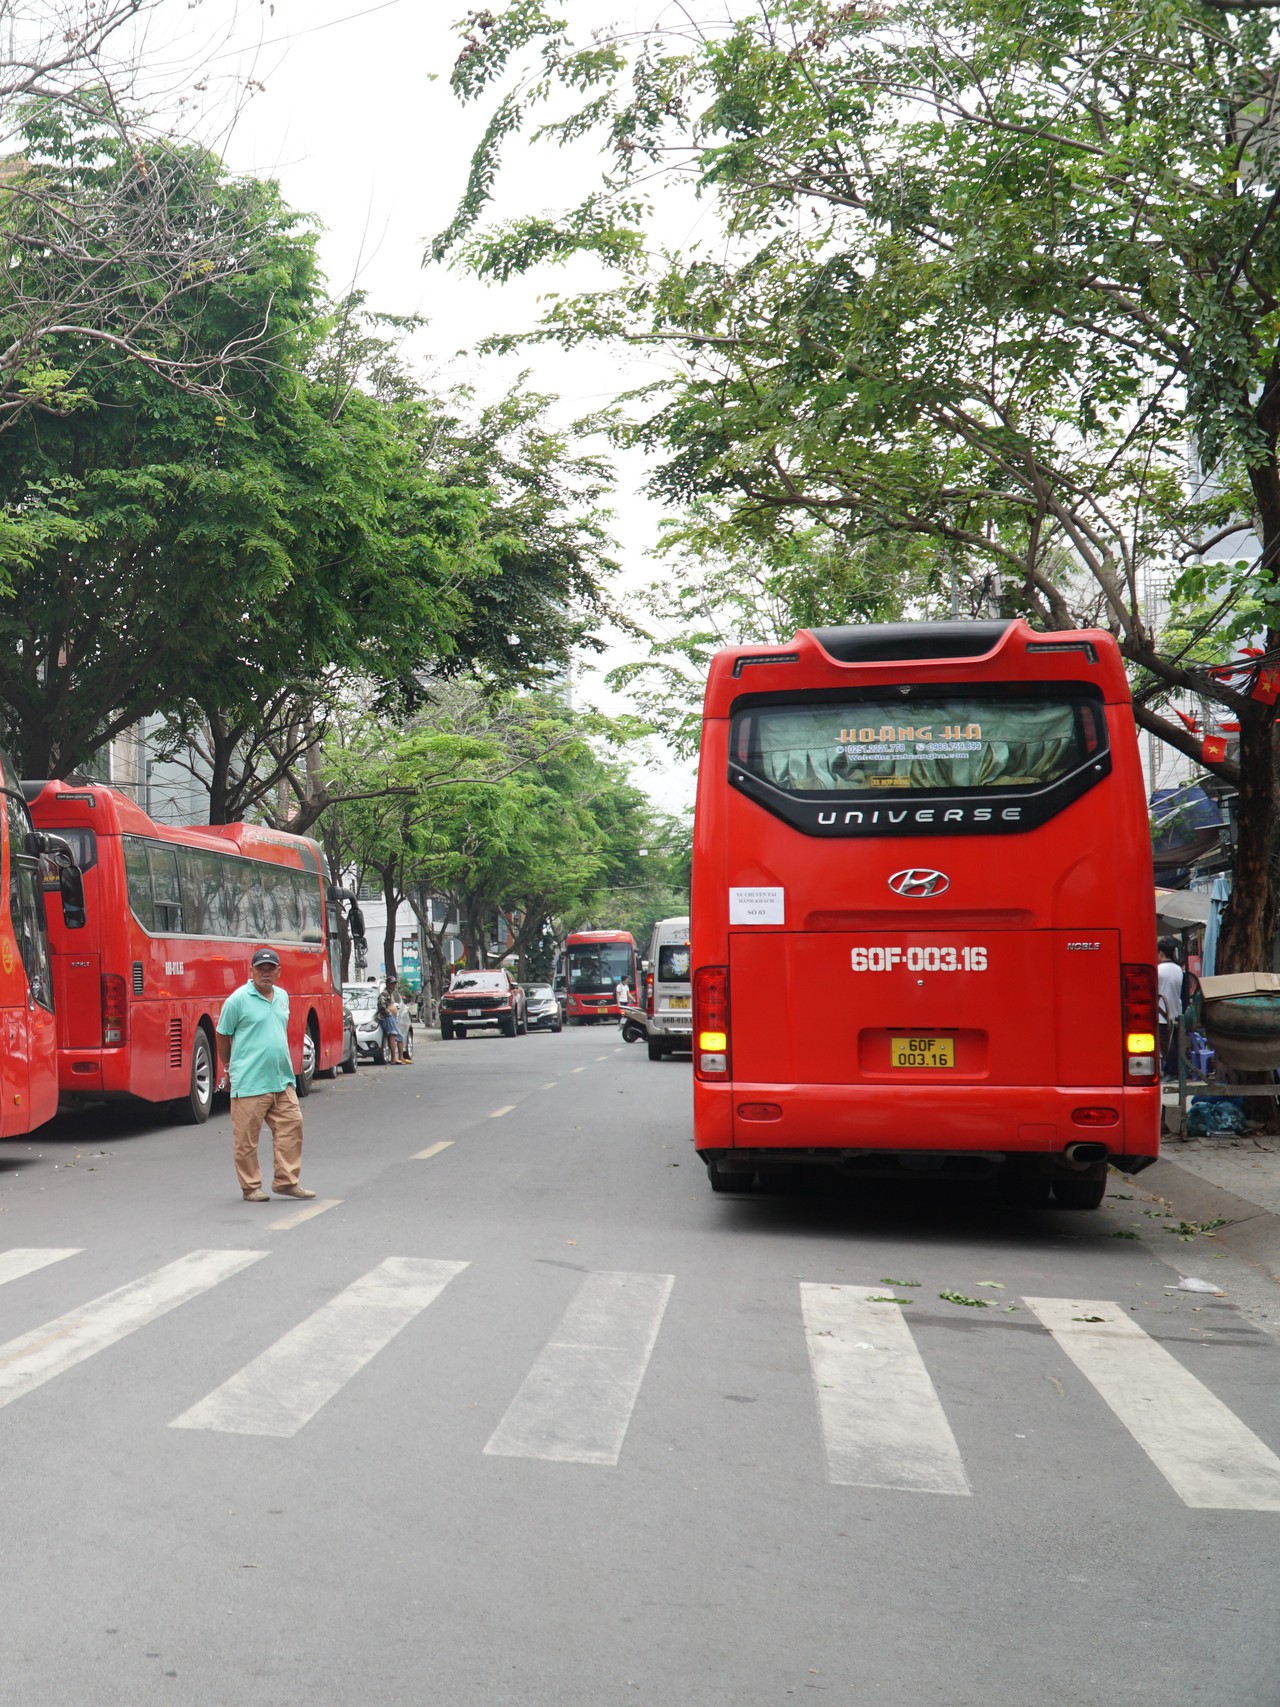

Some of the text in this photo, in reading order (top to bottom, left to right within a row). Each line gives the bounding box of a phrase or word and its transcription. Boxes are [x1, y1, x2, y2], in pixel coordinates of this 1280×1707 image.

[817, 807, 1022, 825] UNIVERSE
[1067, 942, 1101, 951] NOBLE
[851, 946, 988, 972] 60F-003.16
[909, 1039, 936, 1052] 60F
[898, 1053, 948, 1066] 003.16
